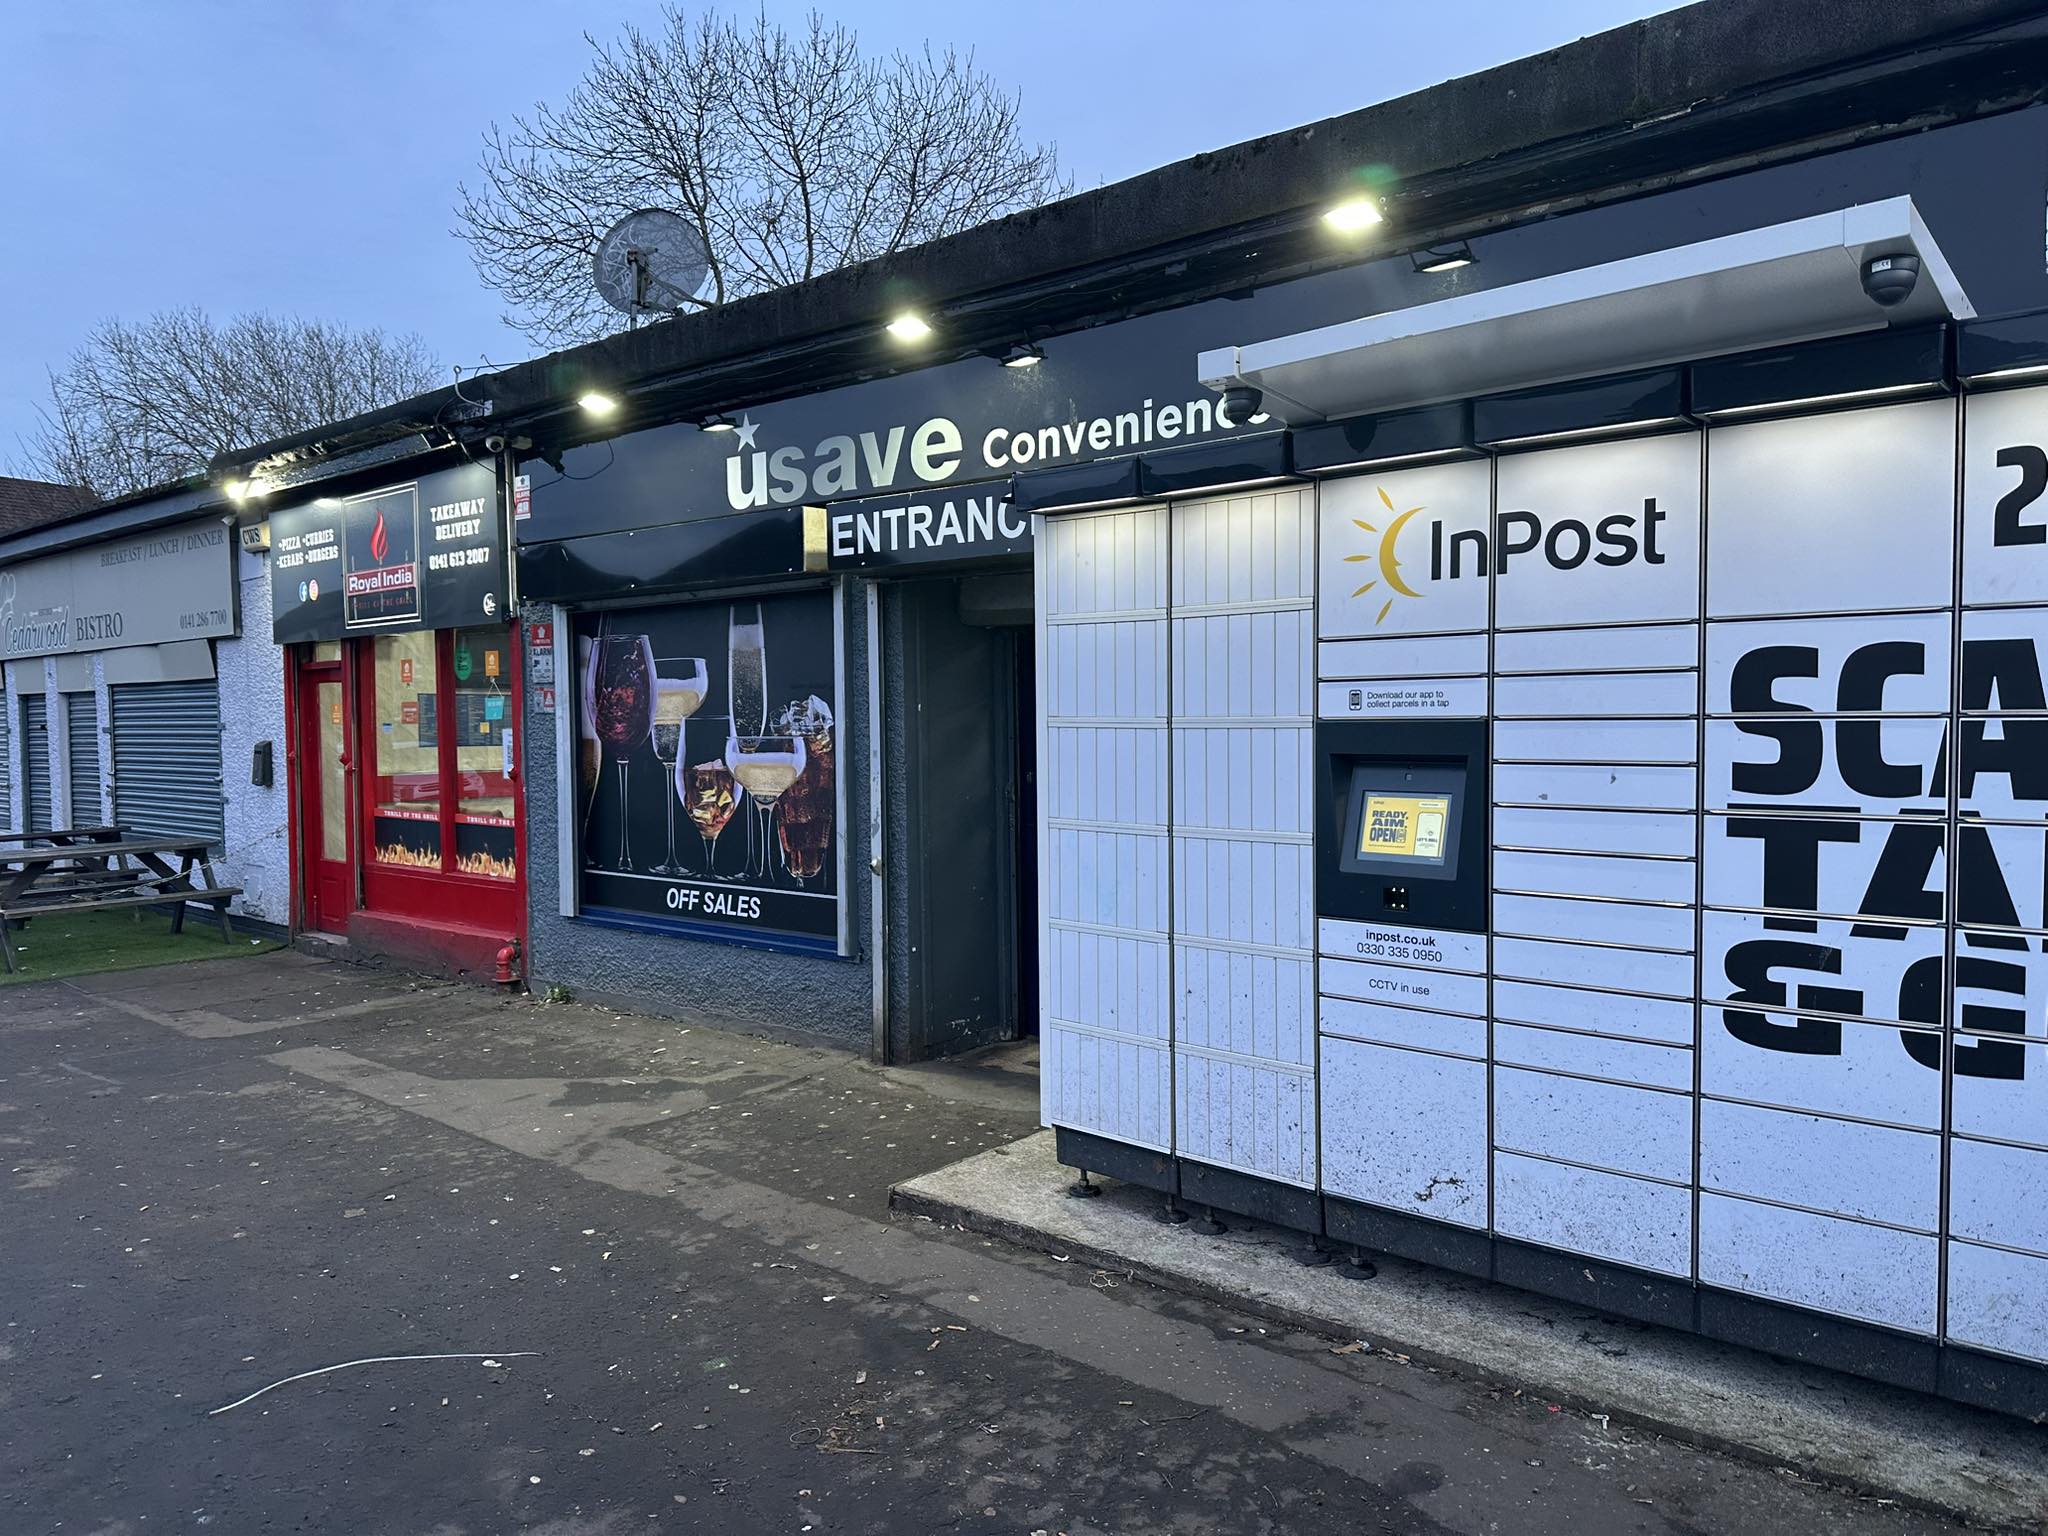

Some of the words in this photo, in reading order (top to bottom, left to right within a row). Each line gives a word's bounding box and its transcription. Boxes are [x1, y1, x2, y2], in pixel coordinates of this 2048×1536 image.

[725, 416, 963, 511] usave
[982, 393, 1271, 468] Convenienc
[430, 498, 485, 522] TAKEAWAY
[242, 528, 260, 545] CWS
[435, 519, 480, 540] DELIVERY
[832, 494, 1034, 557] ENTRANC
[101, 546, 142, 567] BREAKFAST
[150, 538, 179, 558] LUNCH
[187, 529, 224, 550] DINNER
[1431, 498, 1666, 581] InPost
[429, 554, 448, 570] 0141
[449, 551, 465, 568] 613
[466, 547, 489, 565] 2007
[349, 572, 381, 592] Royal
[383, 568, 412, 586] India
[5, 606, 69, 652] Cedarwood
[76, 612, 123, 641] BISTRO
[1367, 691, 1403, 699] Download
[1367, 700, 1390, 708] collect
[1392, 700, 1419, 709] parcels
[1421, 699, 1428, 707] in
[1437, 700, 1449, 708] tap
[1730, 639, 2048, 800] SCA
[383, 810, 402, 818] THRILL
[466, 816, 487, 824] THRILL
[498, 818, 510, 826] THE
[1726, 803, 2048, 953] TA
[666, 888, 699, 911] OFF
[703, 891, 761, 919] SALES
[1366, 930, 1436, 947] inpost.co.uk
[1357, 942, 1385, 956] 0330
[1387, 946, 1409, 959] 335
[1413, 949, 1442, 962] 0950
[1369, 979, 1398, 990] CCTV
[1400, 982, 1409, 992] in
[1412, 985, 1430, 996] use
